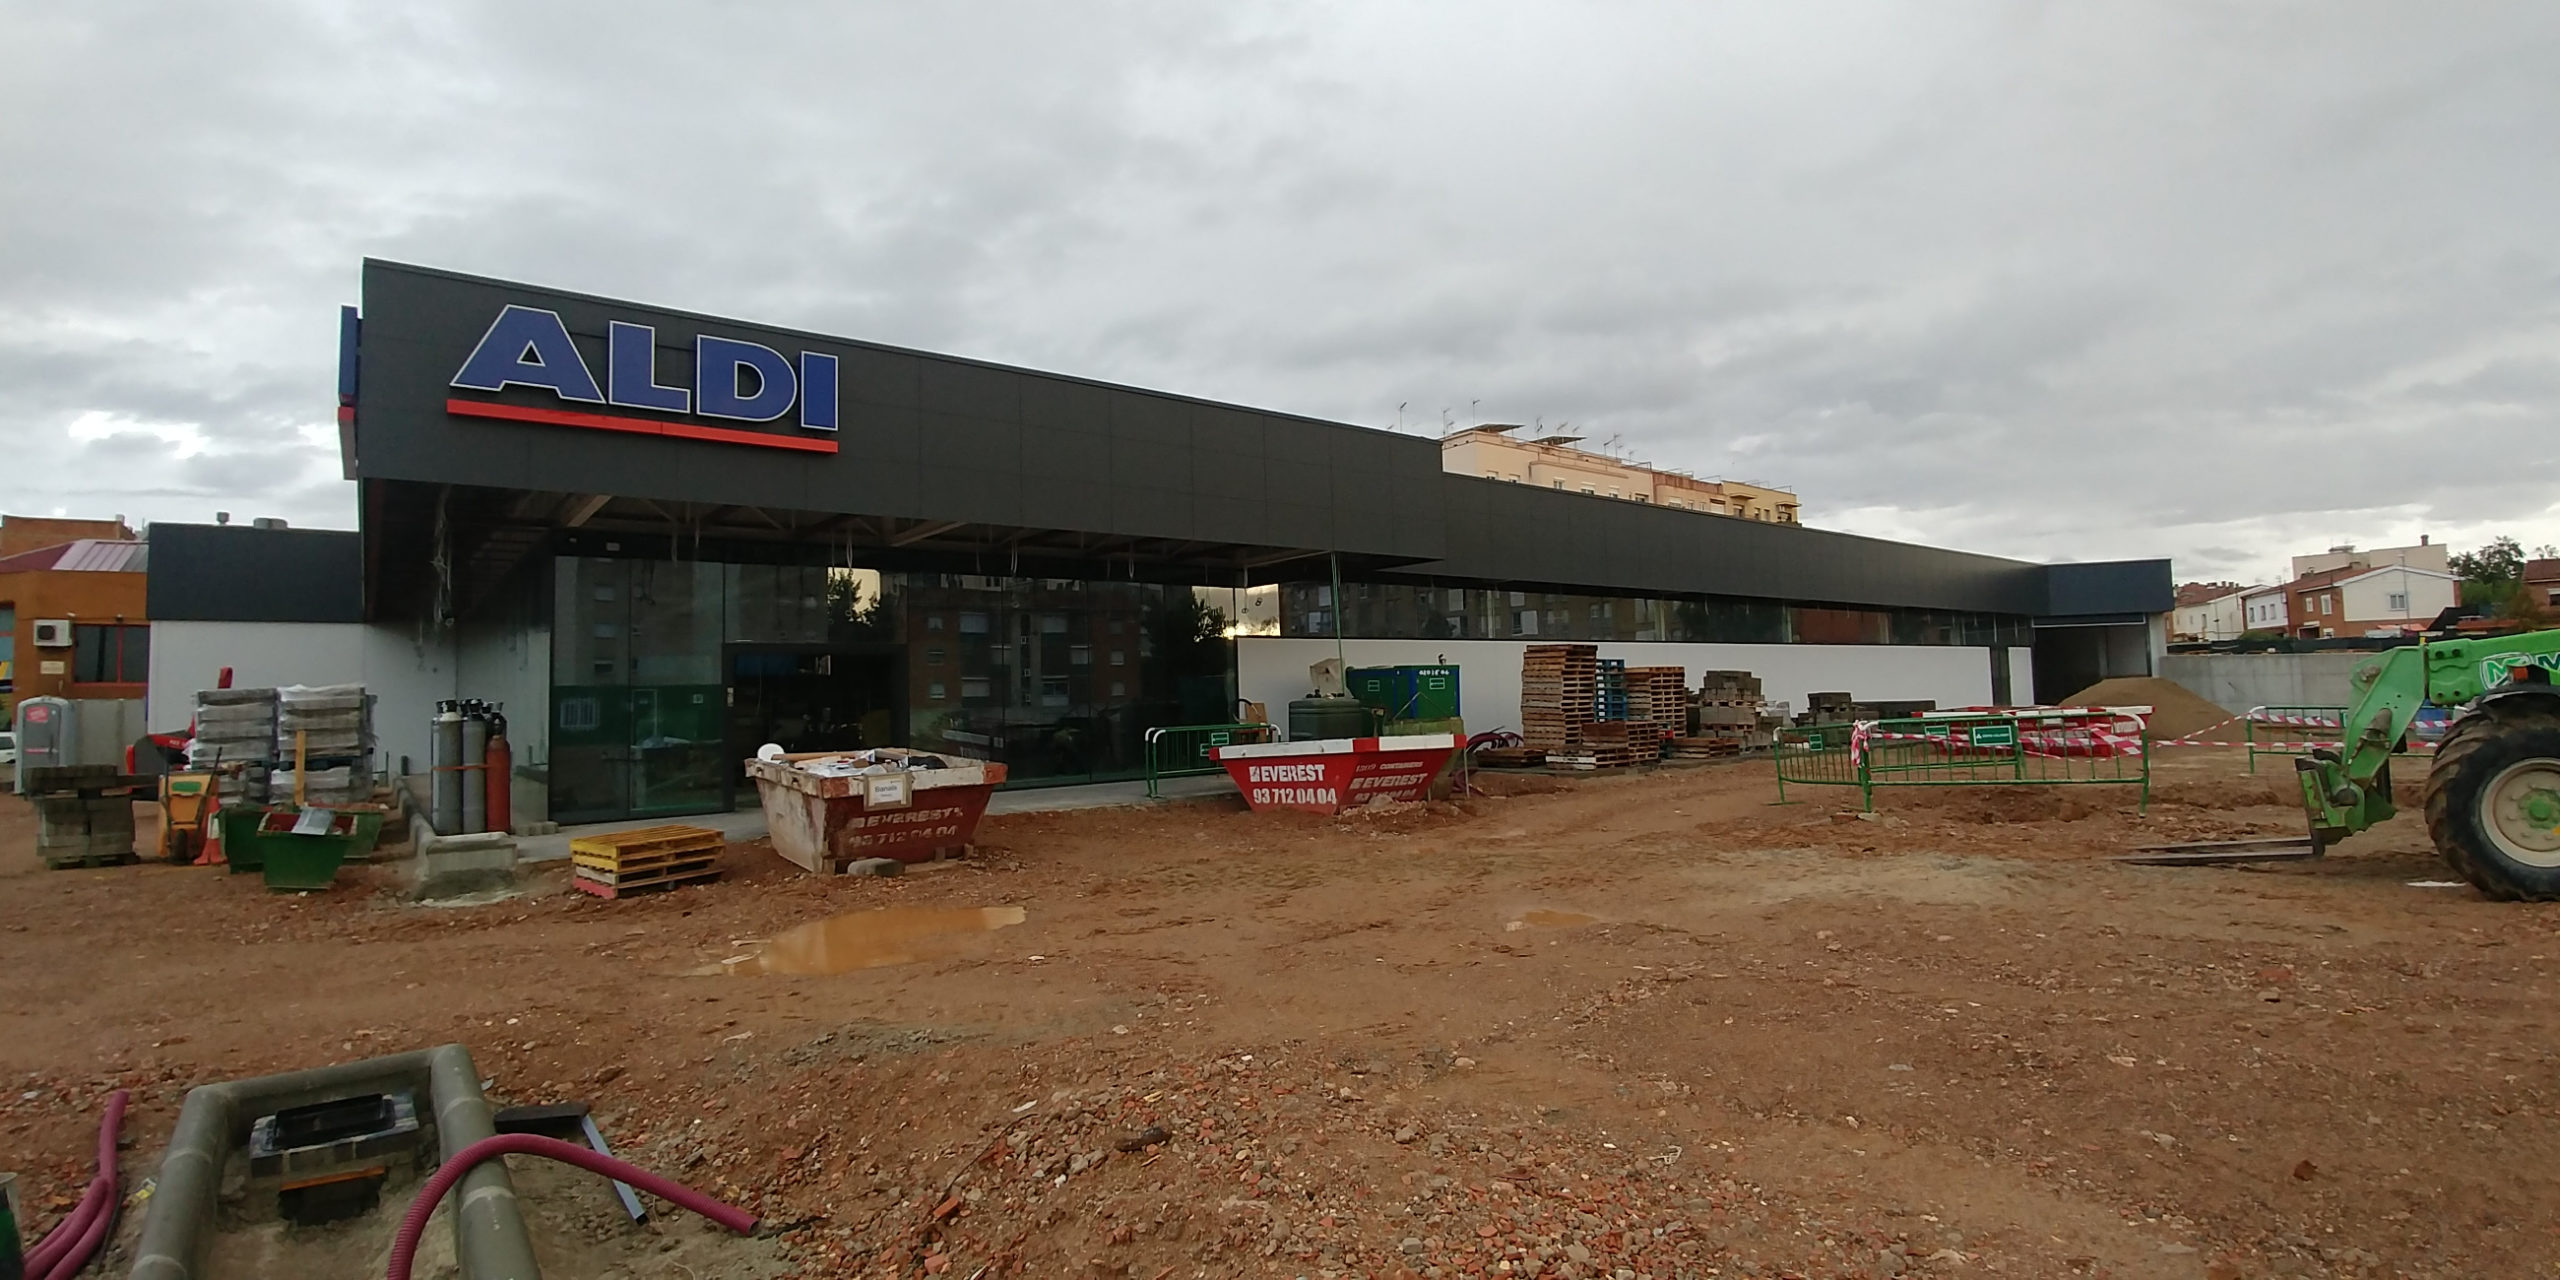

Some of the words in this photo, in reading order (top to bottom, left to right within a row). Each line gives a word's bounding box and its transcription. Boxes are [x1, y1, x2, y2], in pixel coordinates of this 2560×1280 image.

[449, 304, 839, 432] ALDI
[1261, 764, 1325, 782] EVEREST
[1362, 772, 1428, 789] EVEREST
[1253, 788, 1271, 804] 93
[1272, 788, 1295, 804] 712
[1296, 788, 1316, 805] 04
[1317, 788, 1337, 805] 04
